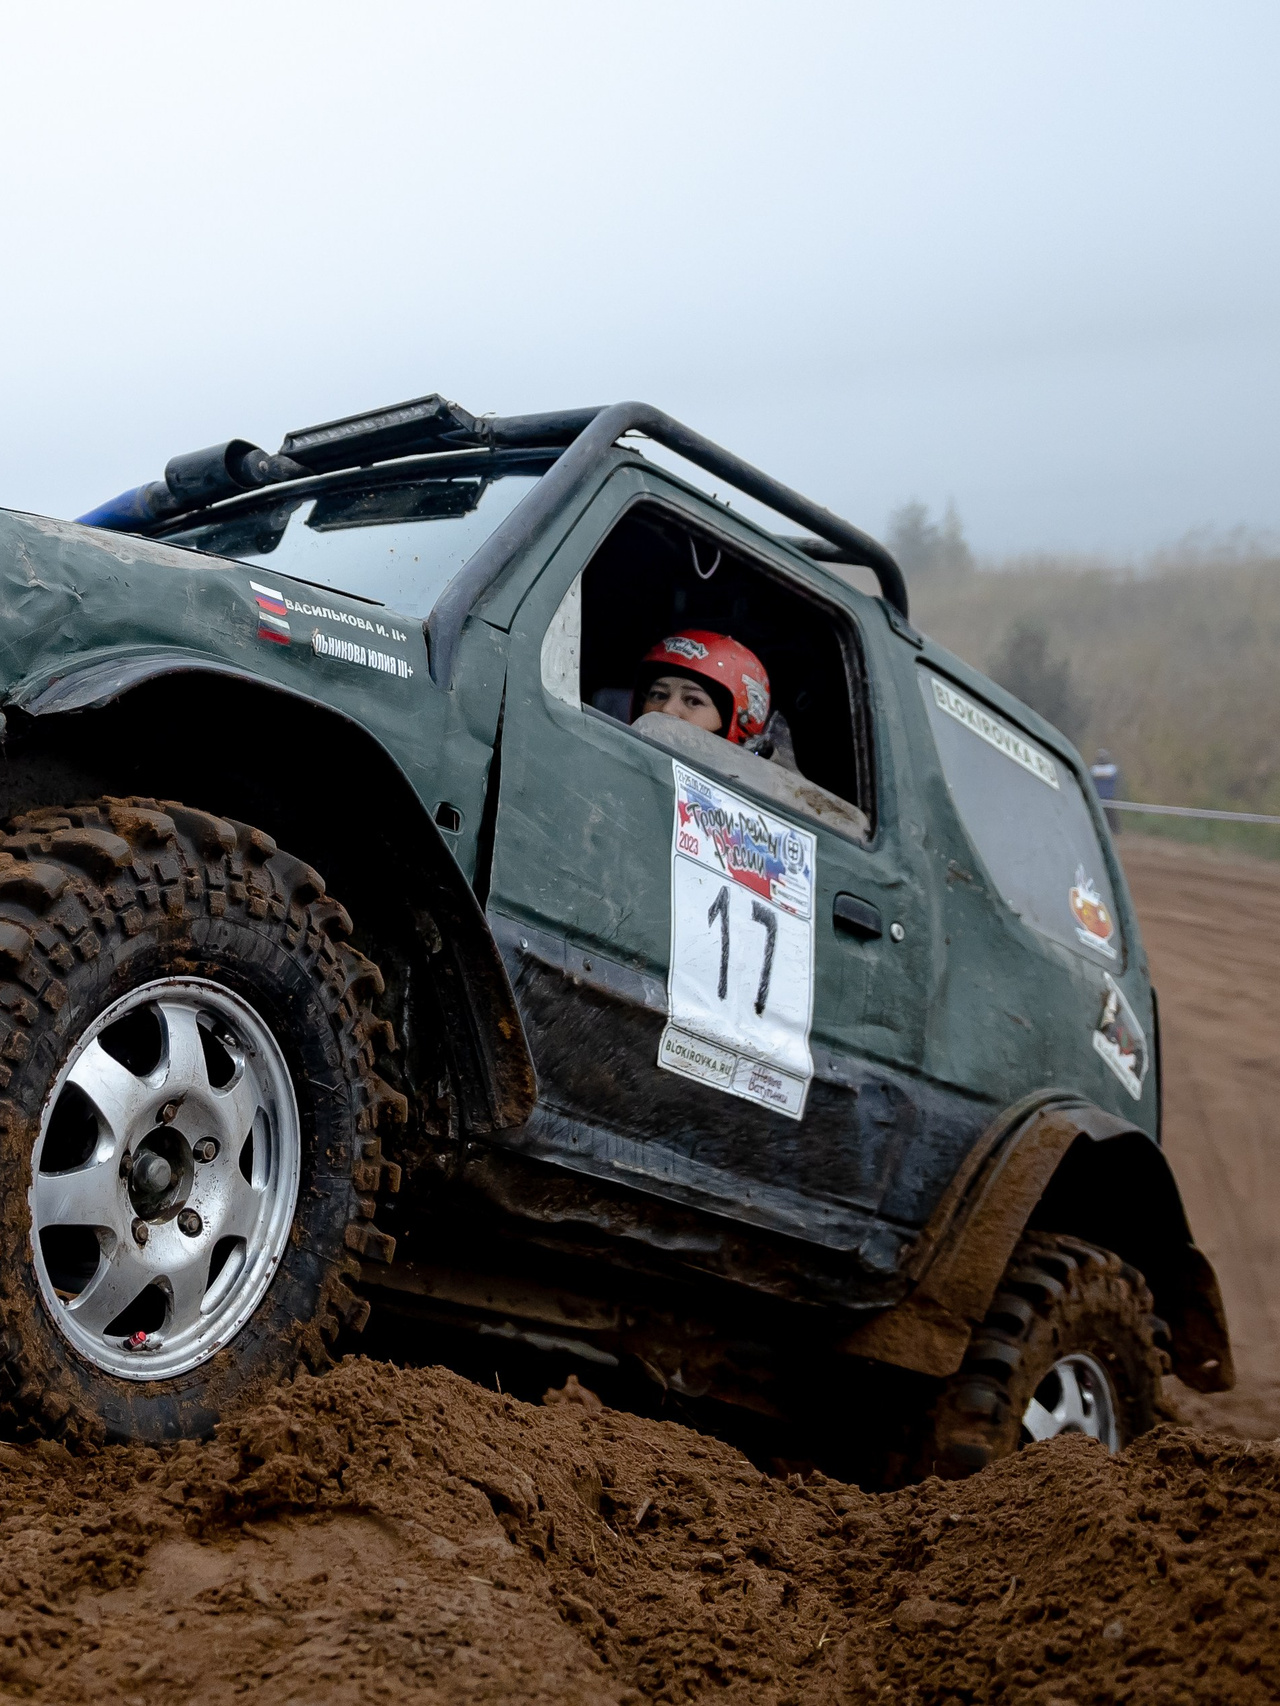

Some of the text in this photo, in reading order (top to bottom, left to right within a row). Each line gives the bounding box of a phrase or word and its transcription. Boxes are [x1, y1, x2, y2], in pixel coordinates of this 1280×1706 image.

[284, 598, 374, 633] ВАСИЛЬКОВА
[375, 623, 389, 638] И.
[367, 648, 397, 675] ЮЛИЯ
[679, 830, 699, 856] 2023
[707, 885, 778, 1017] 17
[665, 1040, 732, 1075] BLOKIROVKA.RU
